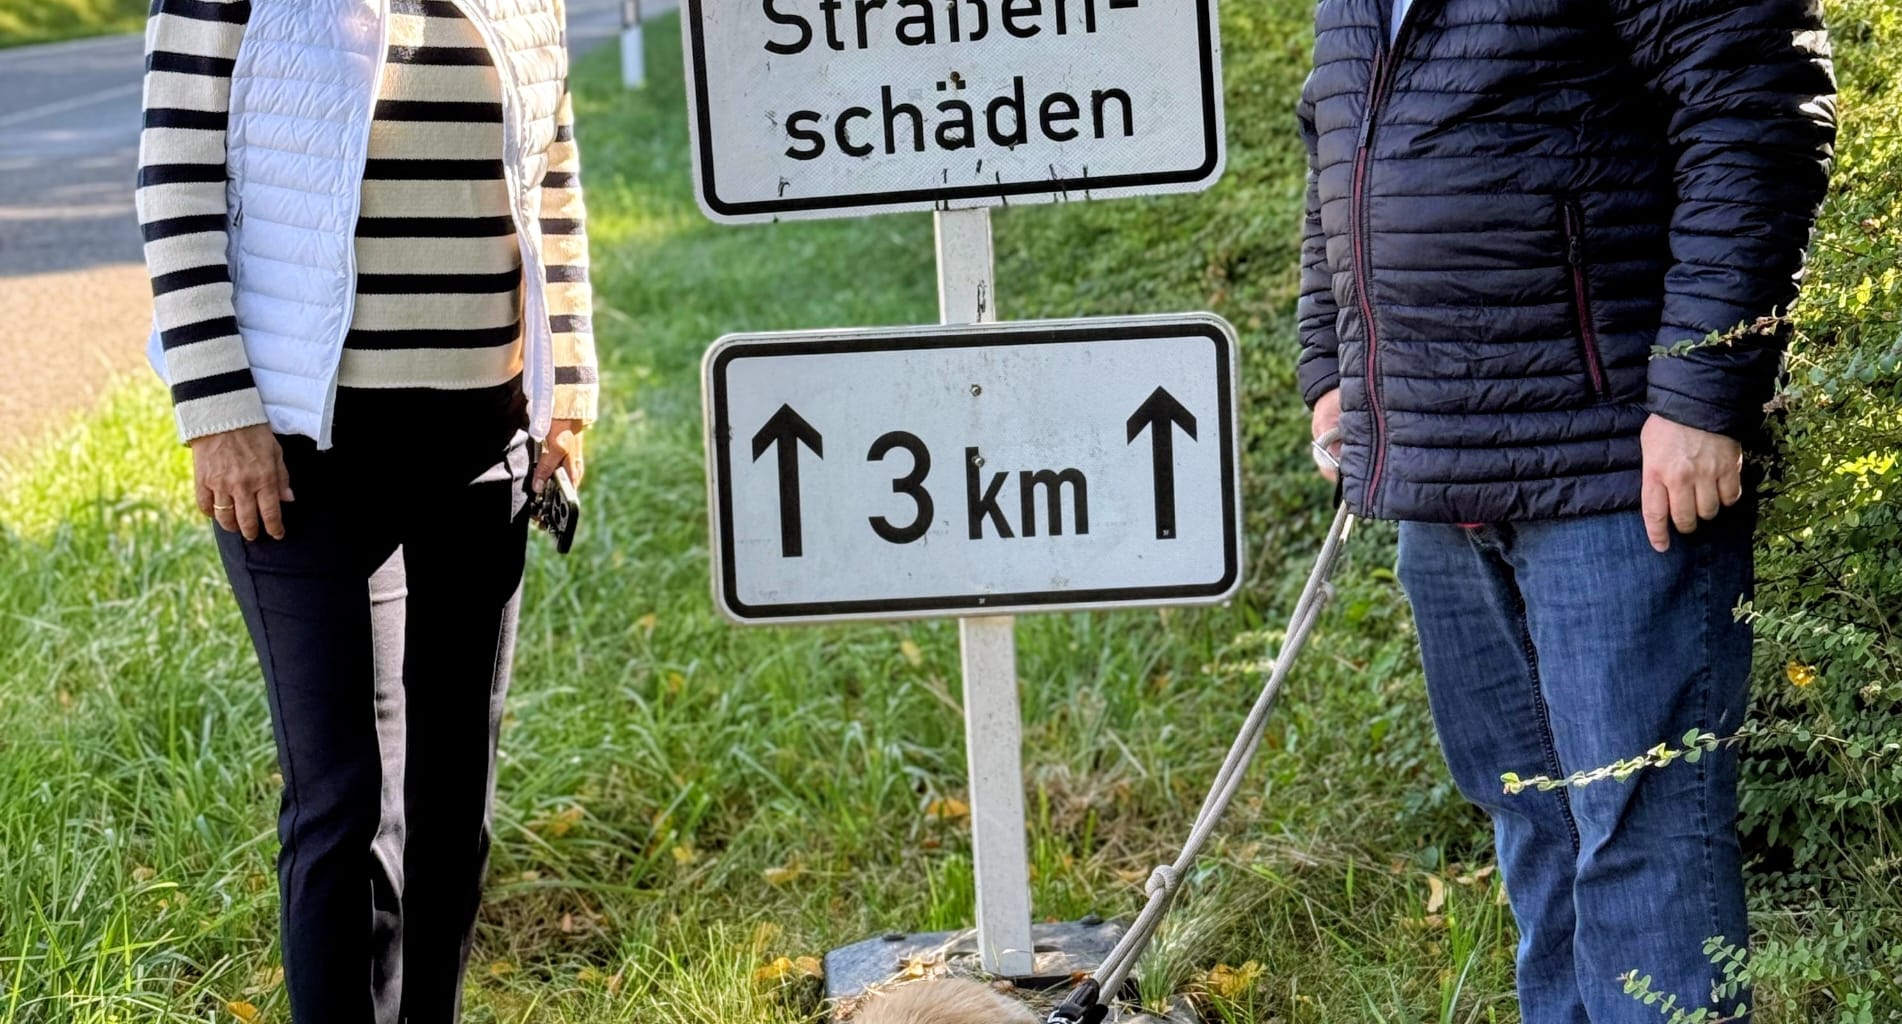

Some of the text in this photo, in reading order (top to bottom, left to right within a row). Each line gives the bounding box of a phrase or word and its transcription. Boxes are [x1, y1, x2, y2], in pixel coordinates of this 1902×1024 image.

[784, 74, 1134, 161] schäden
[866, 430, 1089, 544] 3 km
